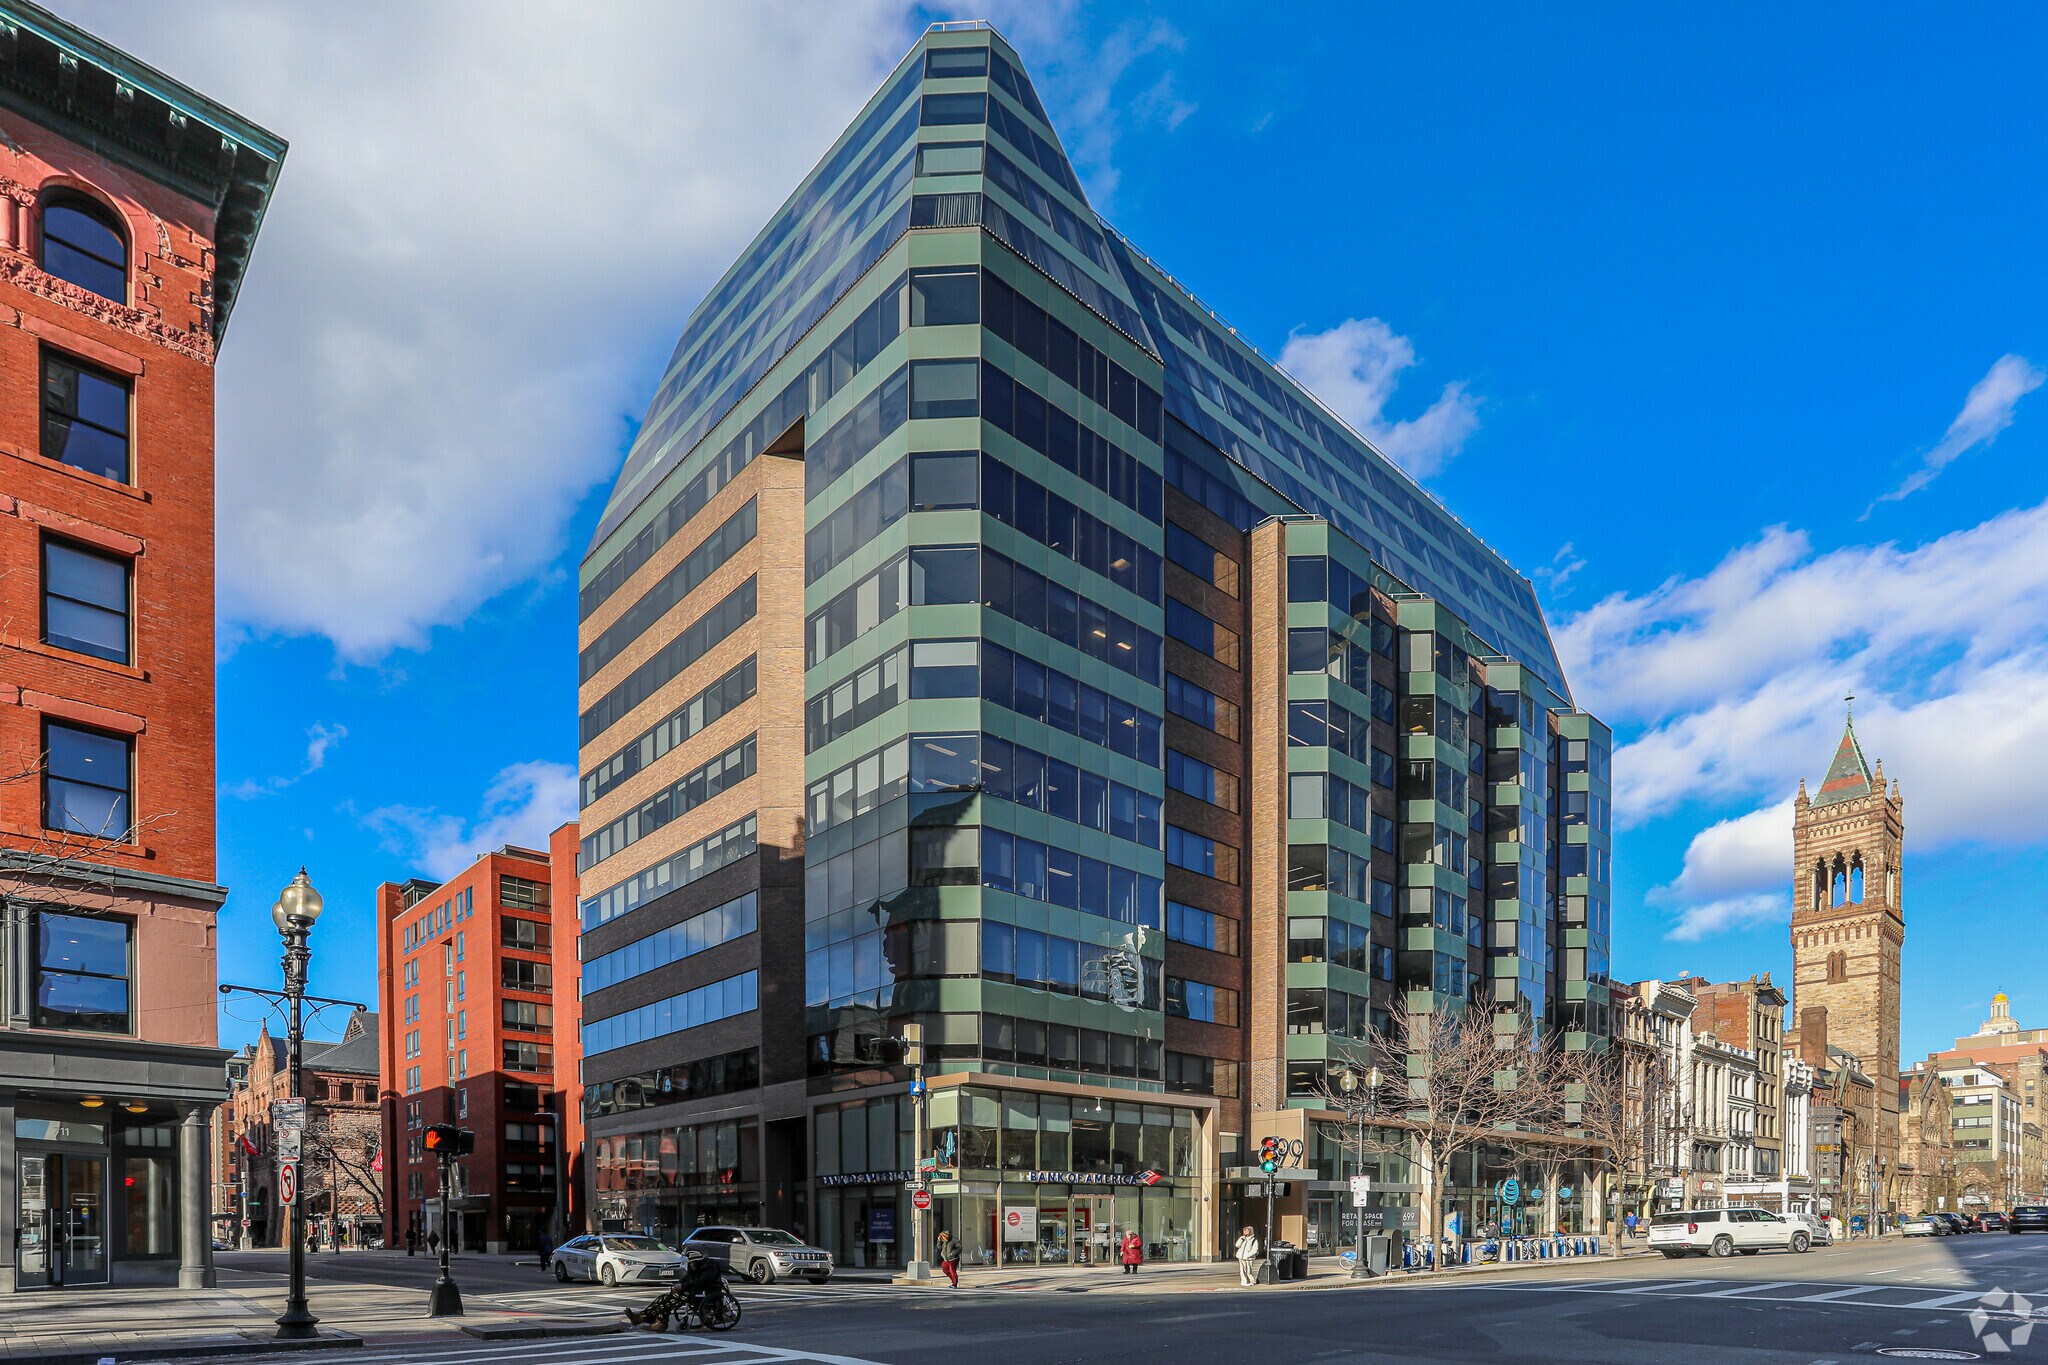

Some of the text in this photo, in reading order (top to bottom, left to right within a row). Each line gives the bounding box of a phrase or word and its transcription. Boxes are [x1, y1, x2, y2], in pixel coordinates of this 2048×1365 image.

[865, 1171, 914, 1183] AMERICA
[1029, 1171, 1137, 1185] BANK OF AMERICA
[1403, 1212, 1415, 1221] 699
